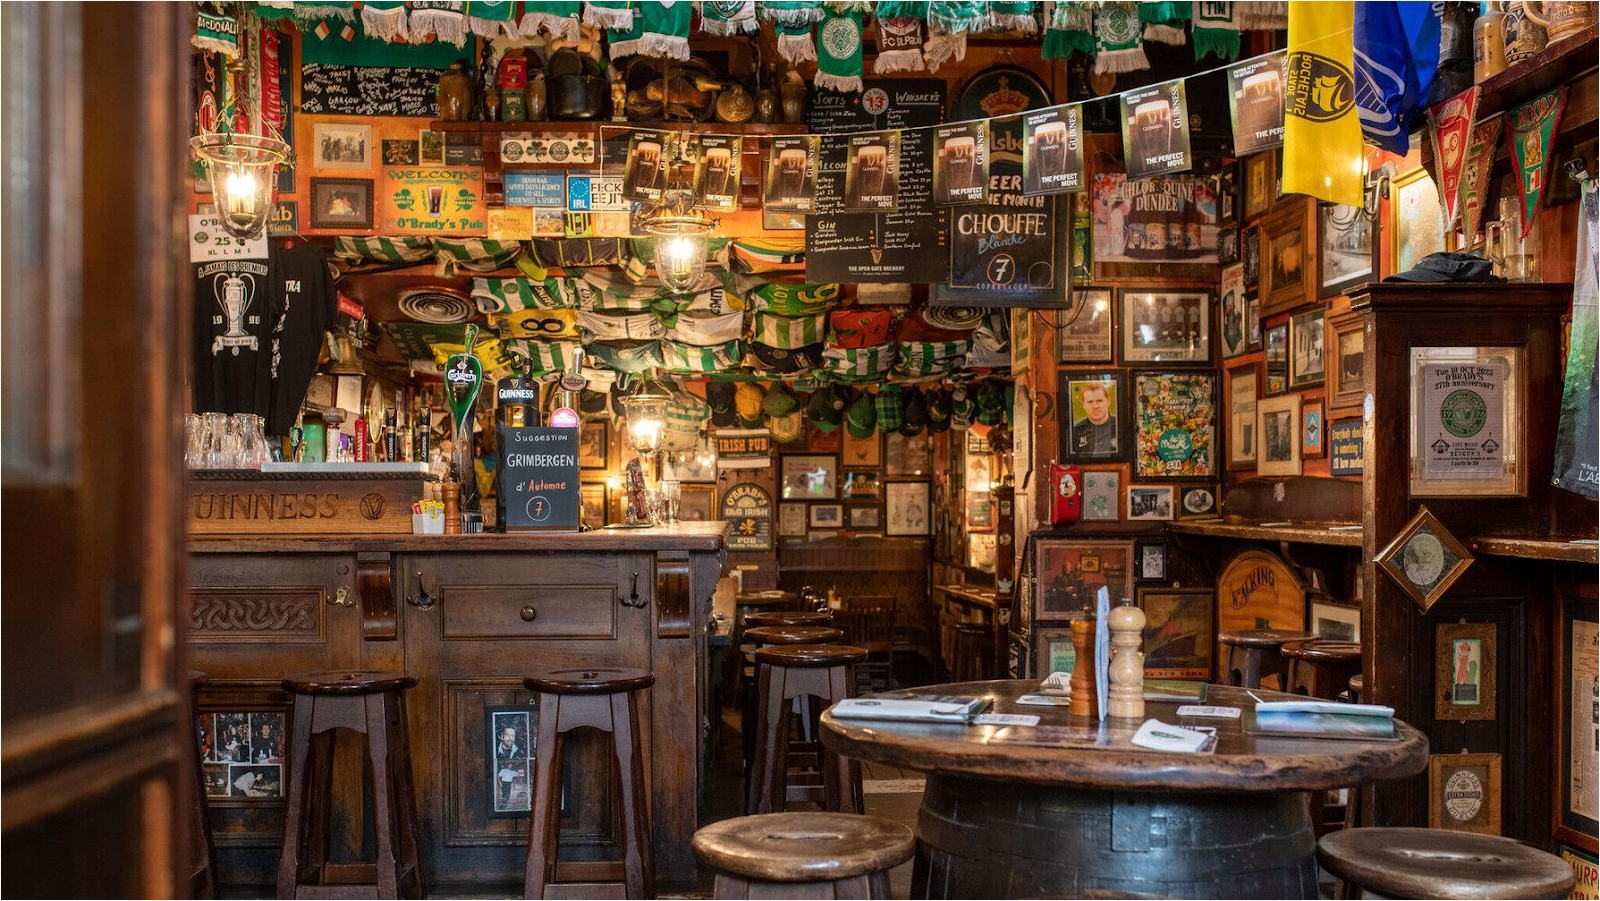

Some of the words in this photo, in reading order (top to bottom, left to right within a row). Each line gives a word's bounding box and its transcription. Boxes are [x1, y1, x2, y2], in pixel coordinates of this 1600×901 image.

[882, 37, 895, 48] FC
[865, 96, 884, 108] 13
[1171, 85, 1182, 129] GUINNESS
[1068, 108, 1077, 151] GUINNESS
[1255, 130, 1268, 139] THE
[1269, 127, 1285, 136] PERF
[975, 124, 985, 165] GUINNESS
[730, 139, 739, 176] GUINNESS
[806, 140, 816, 178] GUINNESS
[886, 135, 896, 174] GUINNESS
[1158, 152, 1184, 163] PERFECT
[1167, 159, 1184, 168] MOVE
[388, 169, 480, 181] WELCOME
[1052, 173, 1078, 182] PERFECT
[591, 183, 622, 192] FECK
[988, 175, 1022, 190] EER
[950, 188, 960, 196] THE
[960, 186, 983, 195] PERFECT
[573, 199, 588, 208] IRL
[1136, 194, 1178, 212] DUNDEE
[397, 218, 456, 230] O'Brady's
[459, 218, 484, 230] Pub
[958, 213, 1048, 236] CHOUFFE
[214, 237, 230, 246] 25
[978, 234, 1026, 255] Blanche
[198, 266, 205, 279] A
[995, 258, 1010, 282] 7
[447, 369, 476, 383] Carlsberg
[1445, 373, 1484, 381] O'BRADY'S
[1434, 381, 1450, 390] 27th
[1452, 380, 1495, 390] anniversary
[499, 388, 534, 400] GUINNESS
[719, 438, 746, 452] IRISH
[748, 438, 767, 451] PUB
[507, 454, 574, 468] GRIMBERGEN
[516, 482, 526, 492] d'
[528, 478, 566, 492] Automne
[193, 492, 340, 521] UINNESS
[535, 502, 544, 516] 7
[725, 508, 743, 516] OLD
[744, 508, 768, 516] IRISH
[737, 536, 756, 544] PUB
[1447, 771, 1480, 789] GUINNESS
[1449, 806, 1478, 820] DUBLIN
